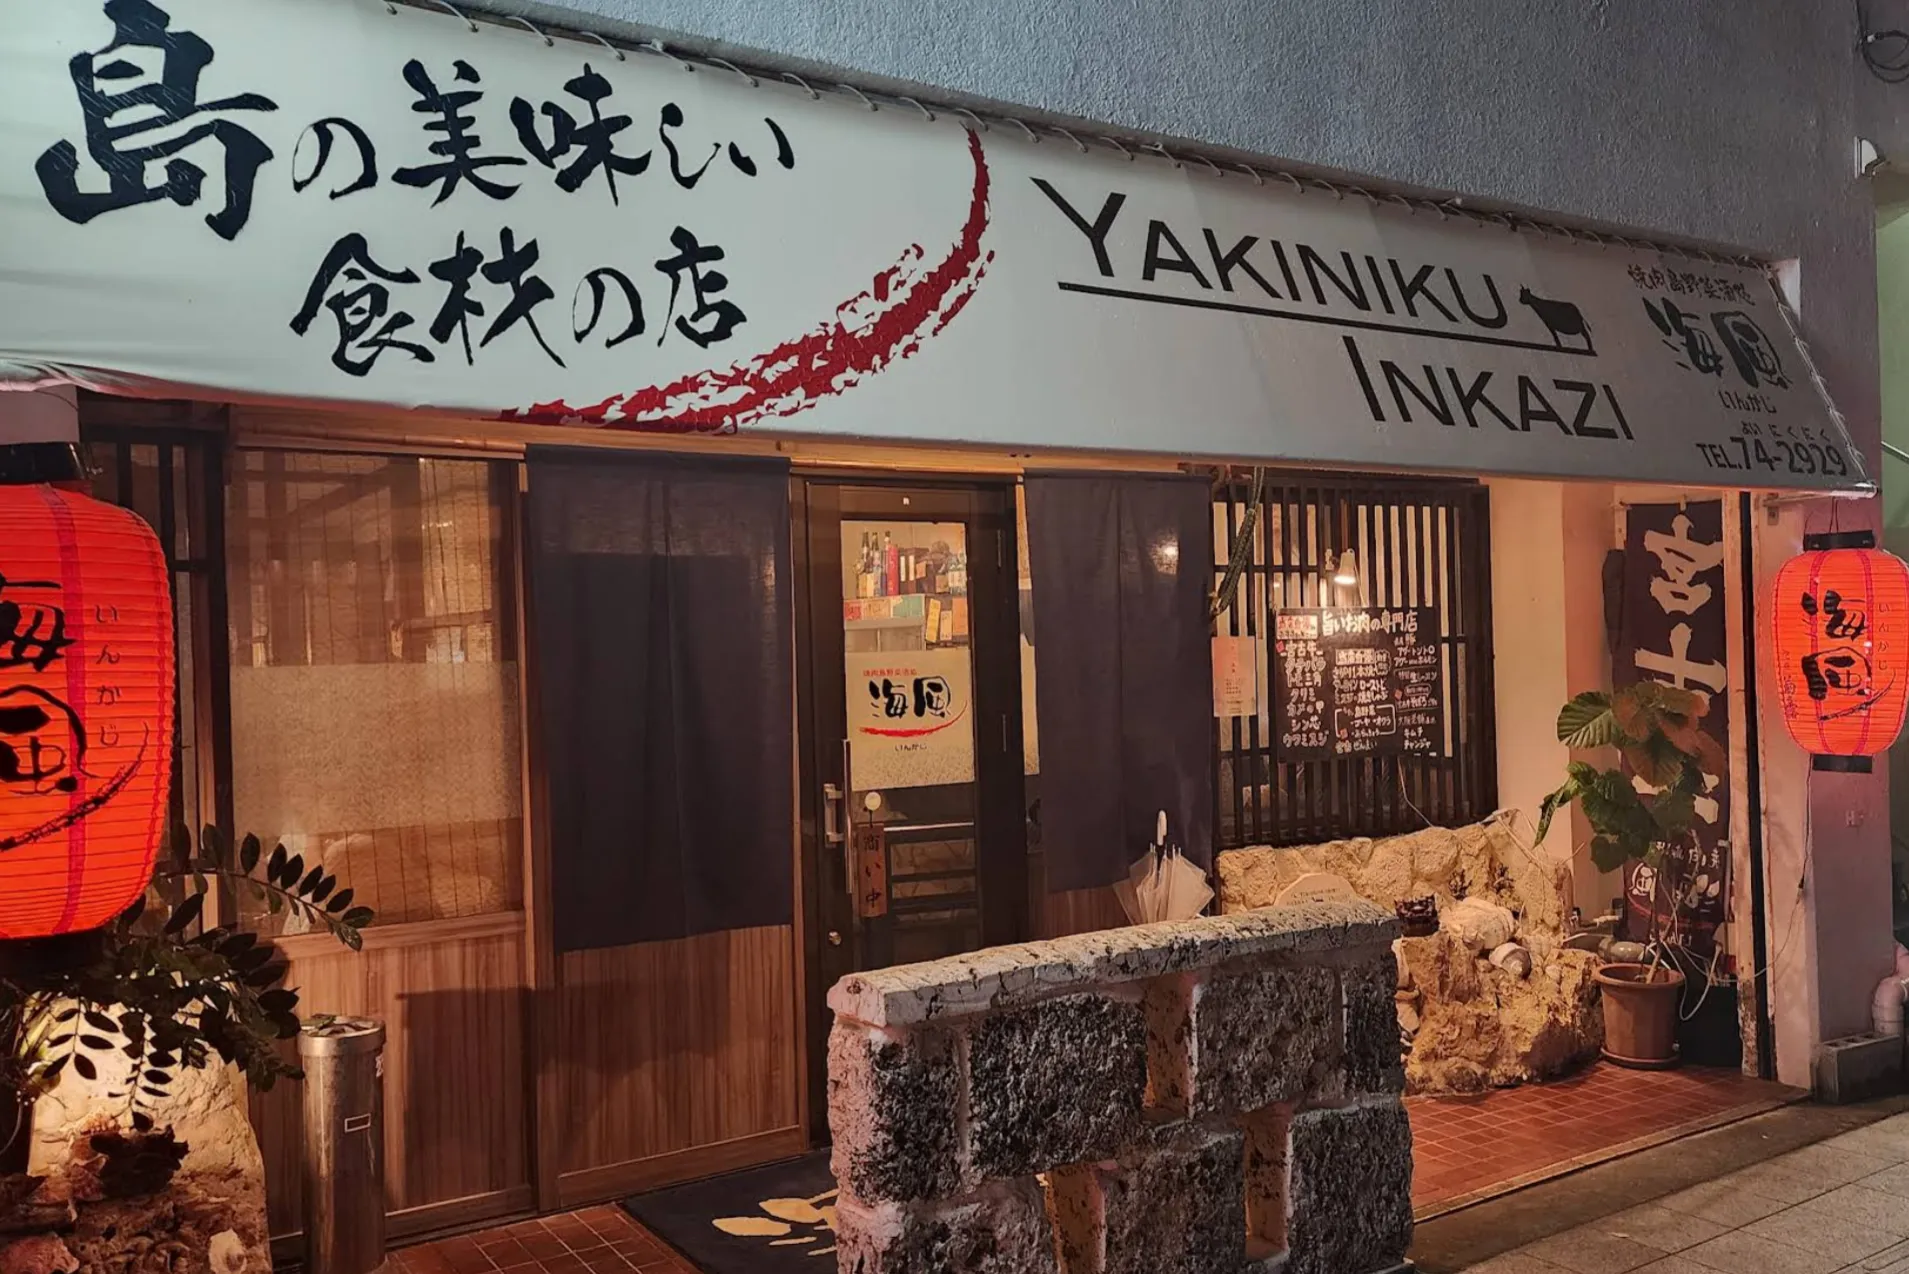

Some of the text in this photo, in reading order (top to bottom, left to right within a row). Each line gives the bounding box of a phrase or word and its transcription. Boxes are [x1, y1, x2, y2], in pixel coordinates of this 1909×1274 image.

[35, 0, 794, 241] 島の美味しい
[290, 226, 747, 376] 食材の店
[1031, 178, 1508, 329] YAKINIKU
[1343, 336, 1634, 440] INKAZI
